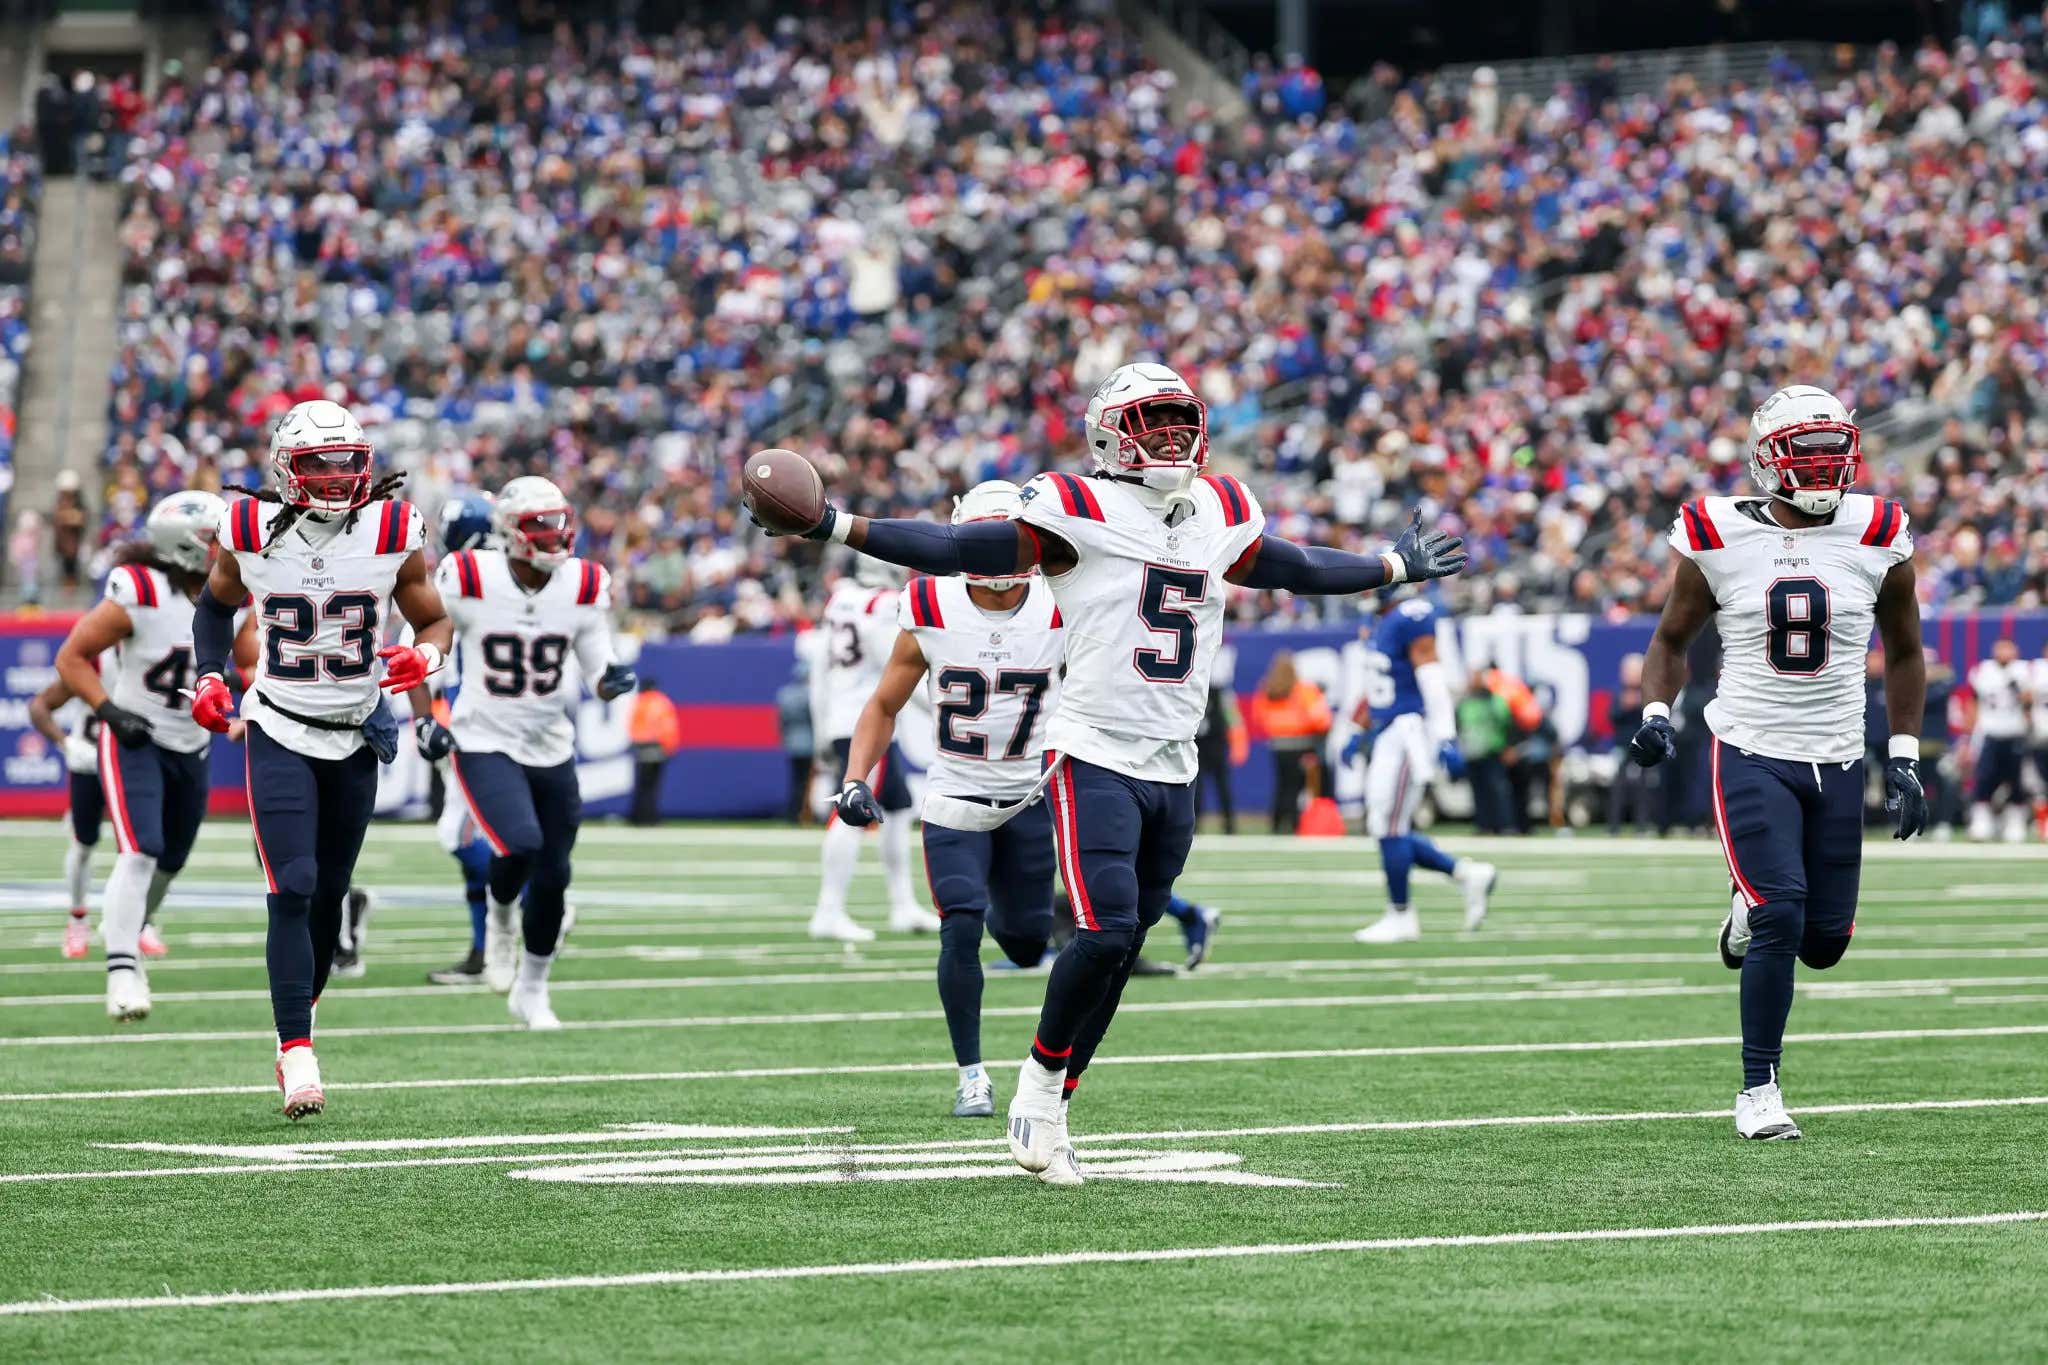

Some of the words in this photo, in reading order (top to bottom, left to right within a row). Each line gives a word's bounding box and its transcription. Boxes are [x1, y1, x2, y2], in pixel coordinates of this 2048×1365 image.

[1774, 557, 1810, 567] PATRIOTS
[261, 590, 380, 682] 23
[481, 633, 569, 698] 99
[1133, 563, 1209, 684] 5
[1765, 576, 1832, 677] 8
[143, 644, 200, 711] 4
[938, 665, 1052, 761] 27
